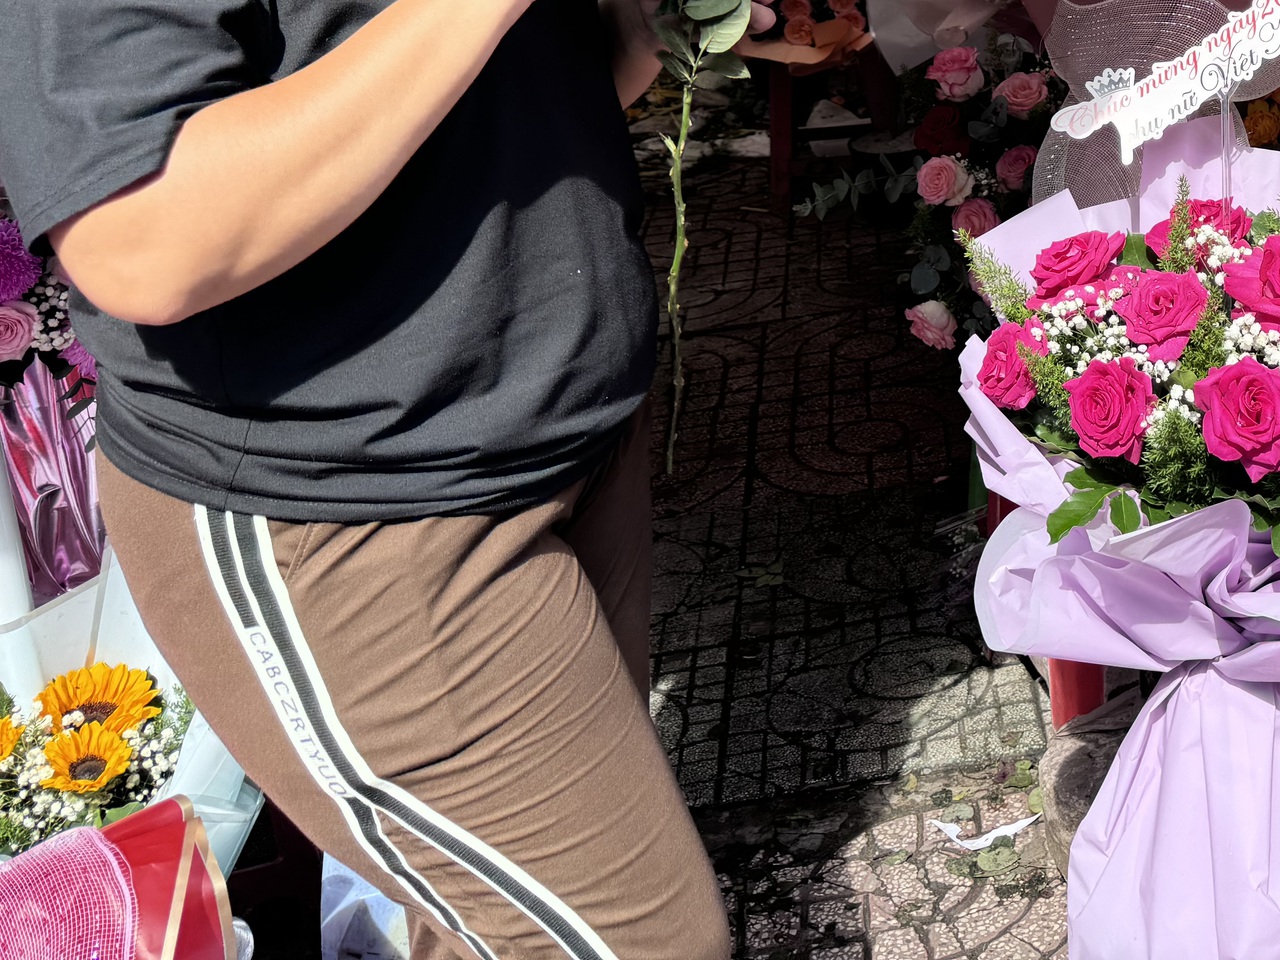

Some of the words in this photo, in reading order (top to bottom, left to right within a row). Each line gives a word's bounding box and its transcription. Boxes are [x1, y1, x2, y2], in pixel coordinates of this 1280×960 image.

[1055, 93, 1132, 136] Chúc
[1136, 47, 1202, 98] mừng
[1167, 88, 1199, 120] nữ
[1200, 39, 1260, 92] Việt
